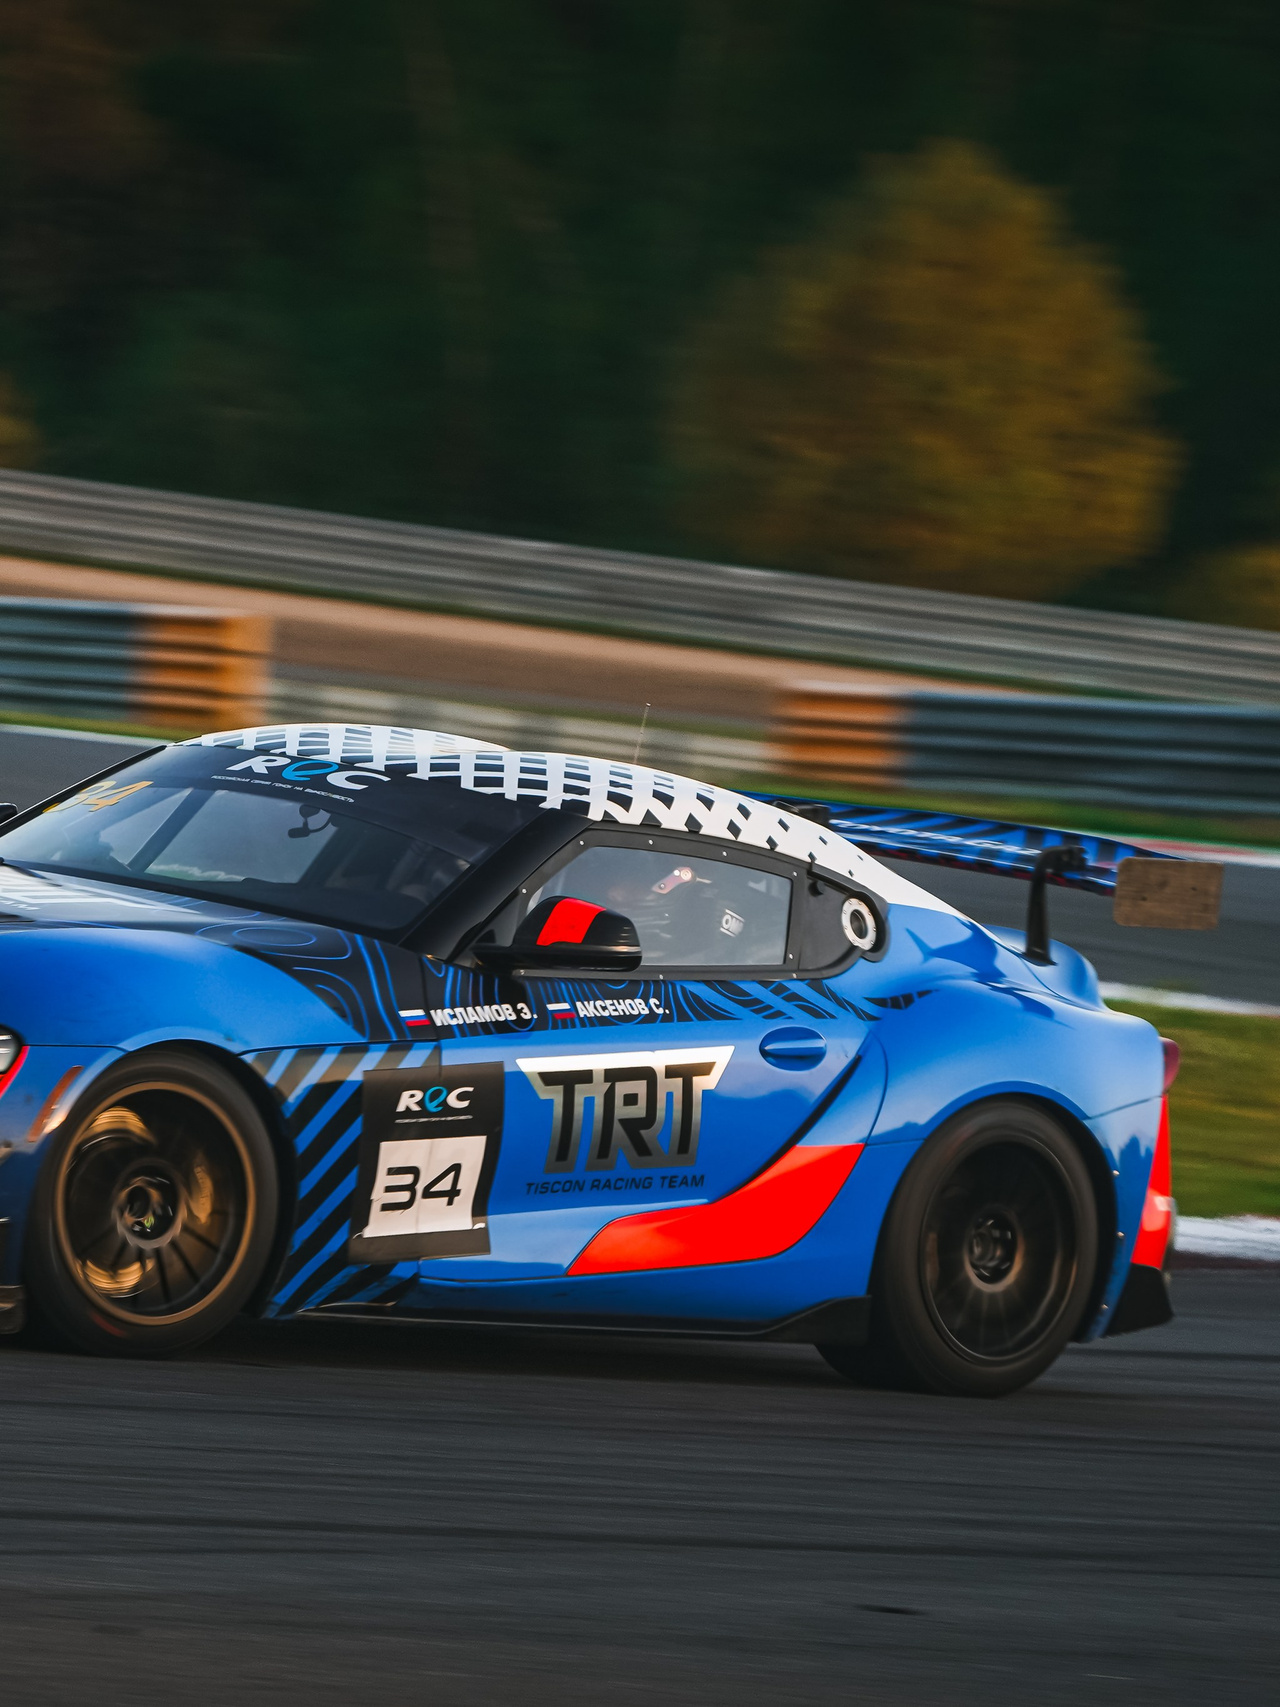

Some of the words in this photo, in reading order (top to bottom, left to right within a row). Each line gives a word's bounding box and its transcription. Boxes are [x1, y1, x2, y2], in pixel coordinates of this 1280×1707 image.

[429, 1003, 515, 1027] ИСЛАМОВ
[575, 998, 648, 1018] АКСЕНОВ
[526, 1054, 725, 1170] TRT
[379, 1162, 462, 1212] 34
[525, 1180, 586, 1196] TISCON
[589, 1177, 654, 1192] RACING
[659, 1174, 706, 1189] TEAM
